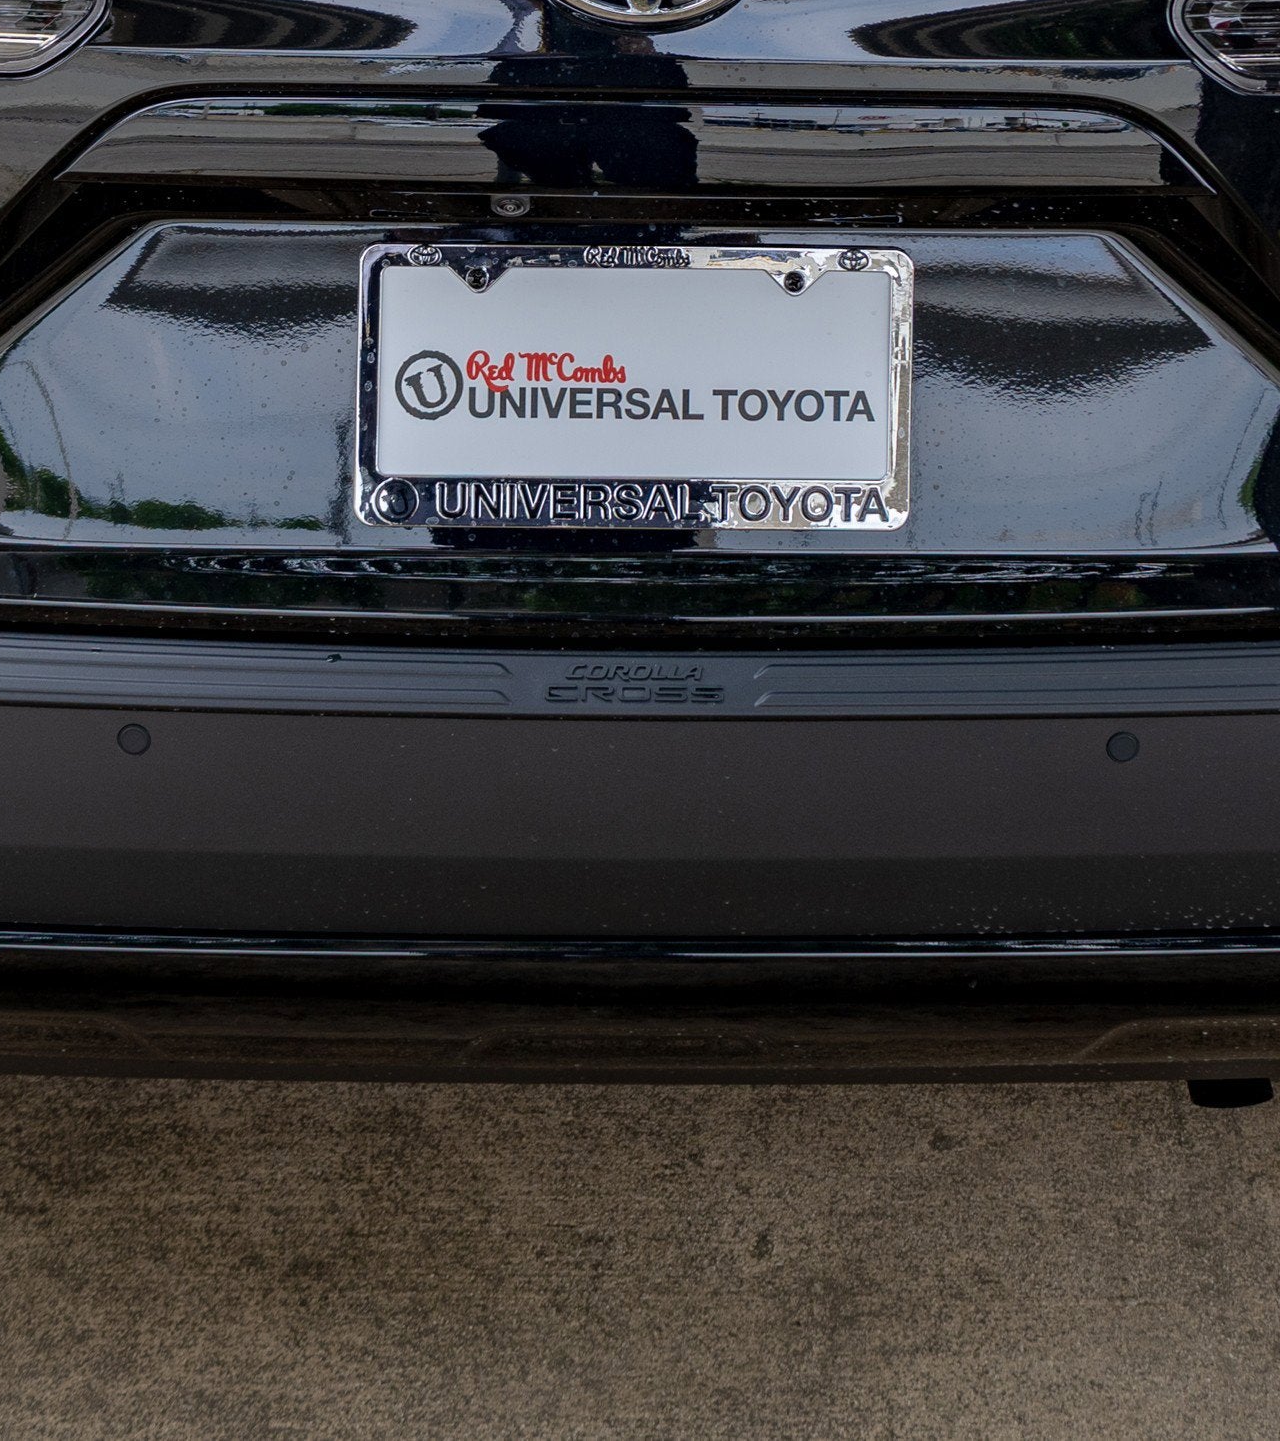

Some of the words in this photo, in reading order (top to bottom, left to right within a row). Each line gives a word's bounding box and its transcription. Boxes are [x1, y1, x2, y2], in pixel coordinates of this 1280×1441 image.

[583, 245, 619, 269] Red
[466, 349, 516, 393] Red
[518, 352, 627, 384] McCombs
[468, 386, 705, 420] UNIVERSAL
[713, 388, 876, 423] TOYOTA
[435, 481, 703, 521] UNIVERSAL
[710, 484, 889, 524] TOYOTA
[565, 663, 705, 682] COROLLA
[545, 685, 725, 704] CROSS
